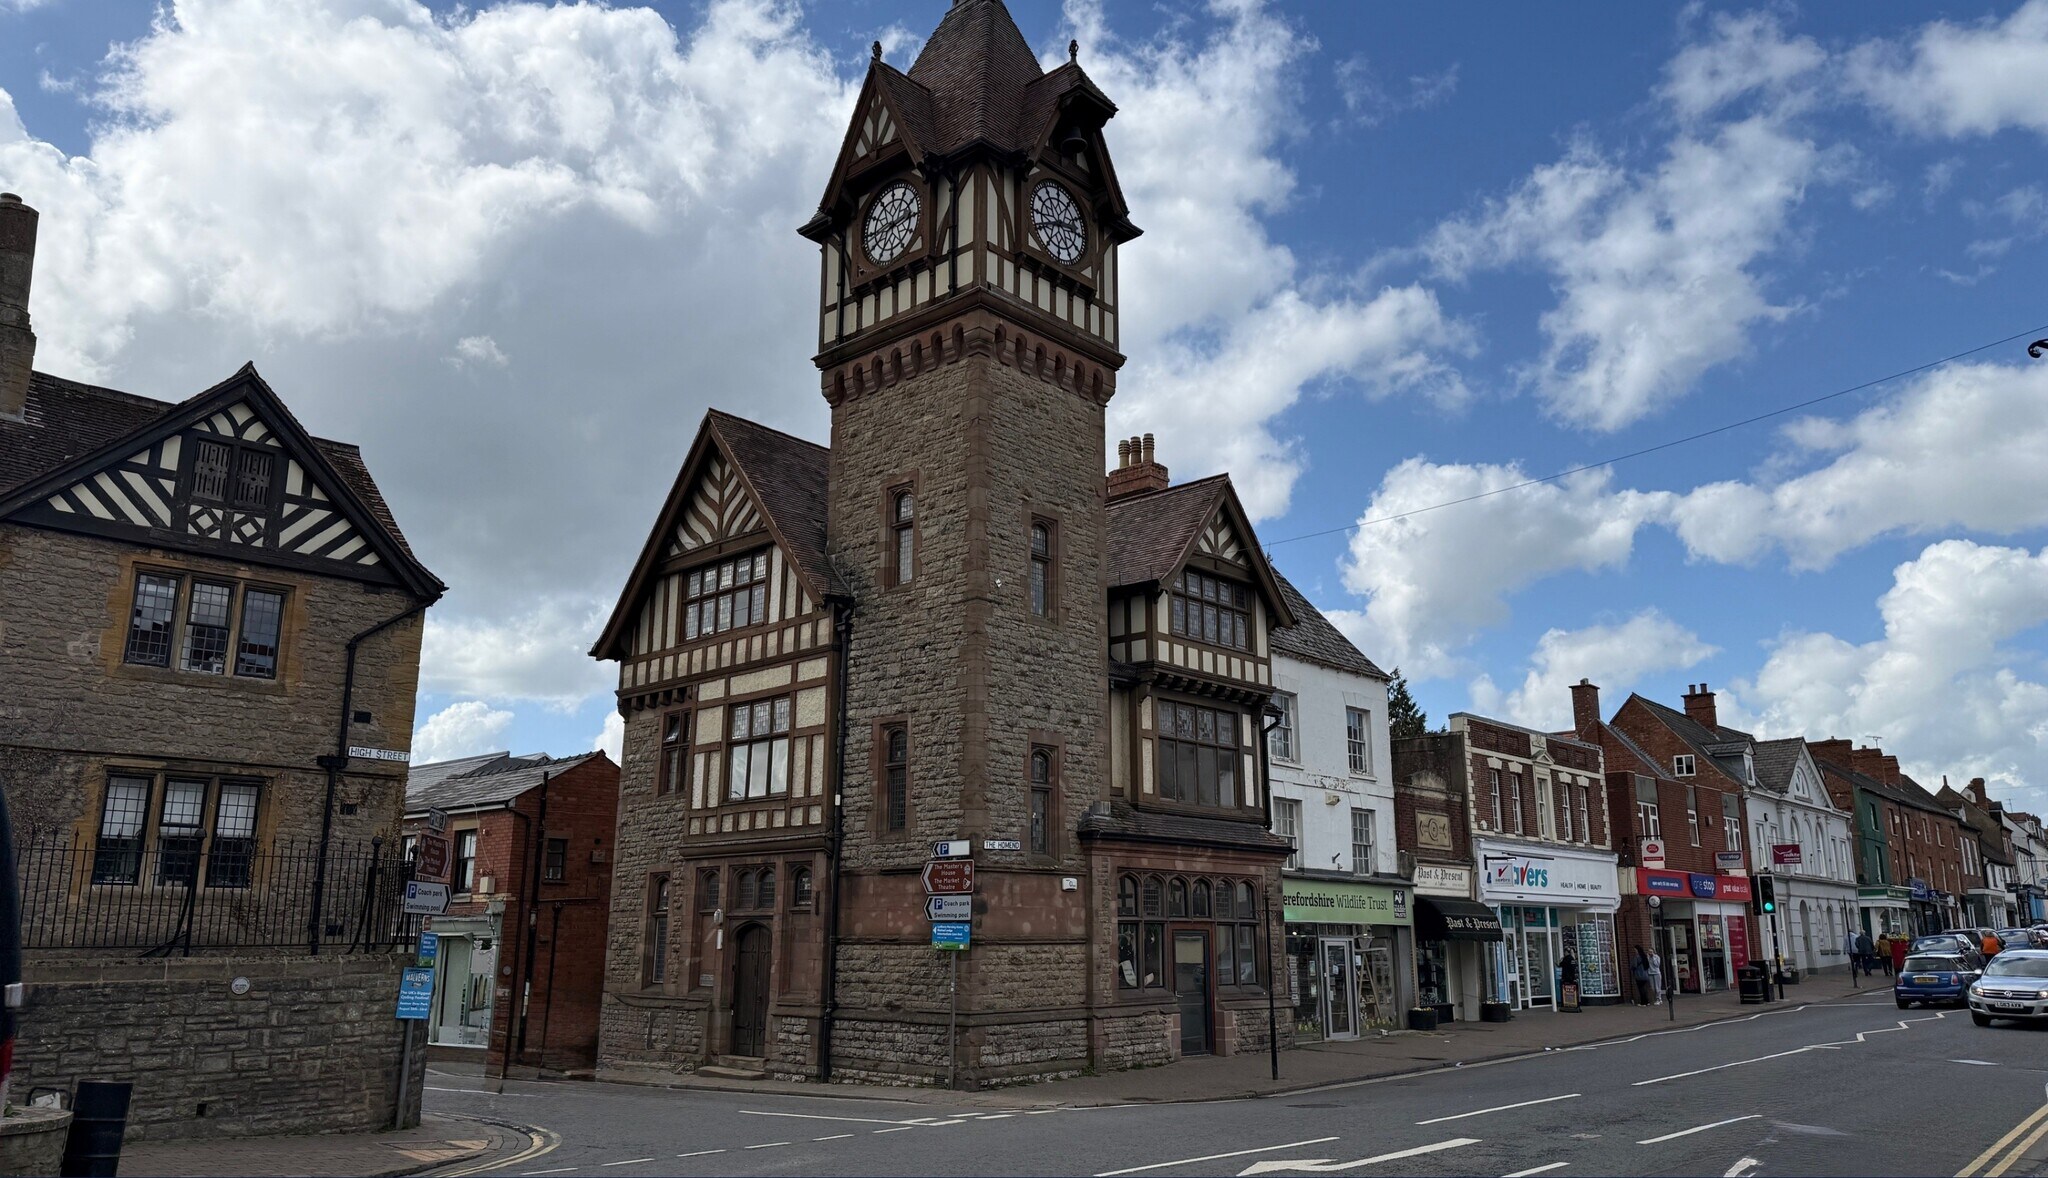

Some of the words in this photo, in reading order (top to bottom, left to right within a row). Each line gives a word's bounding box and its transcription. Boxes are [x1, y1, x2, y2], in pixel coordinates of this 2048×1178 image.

[350, 747, 372, 757] HIGH
[376, 749, 409, 761] STREET
[997, 841, 1020, 849] HOMEND
[1418, 866, 1432, 880] Past
[1433, 869, 1439, 879] &
[1440, 868, 1463, 881] Present
[409, 885, 416, 897] P
[417, 888, 432, 896] Coach
[1703, 879, 1715, 894] stop
[406, 902, 430, 912] Swimming
[430, 904, 441, 912] pool
[936, 899, 942, 909] P
[1283, 891, 1335, 908] erefordshire
[1335, 894, 1366, 909] Wildlife
[1367, 896, 1388, 911] Trust
[1445, 916, 1465, 930] Past
[1465, 917, 1473, 928] &
[1472, 917, 1500, 930] Present
[406, 972, 430, 982] MALVERNS
